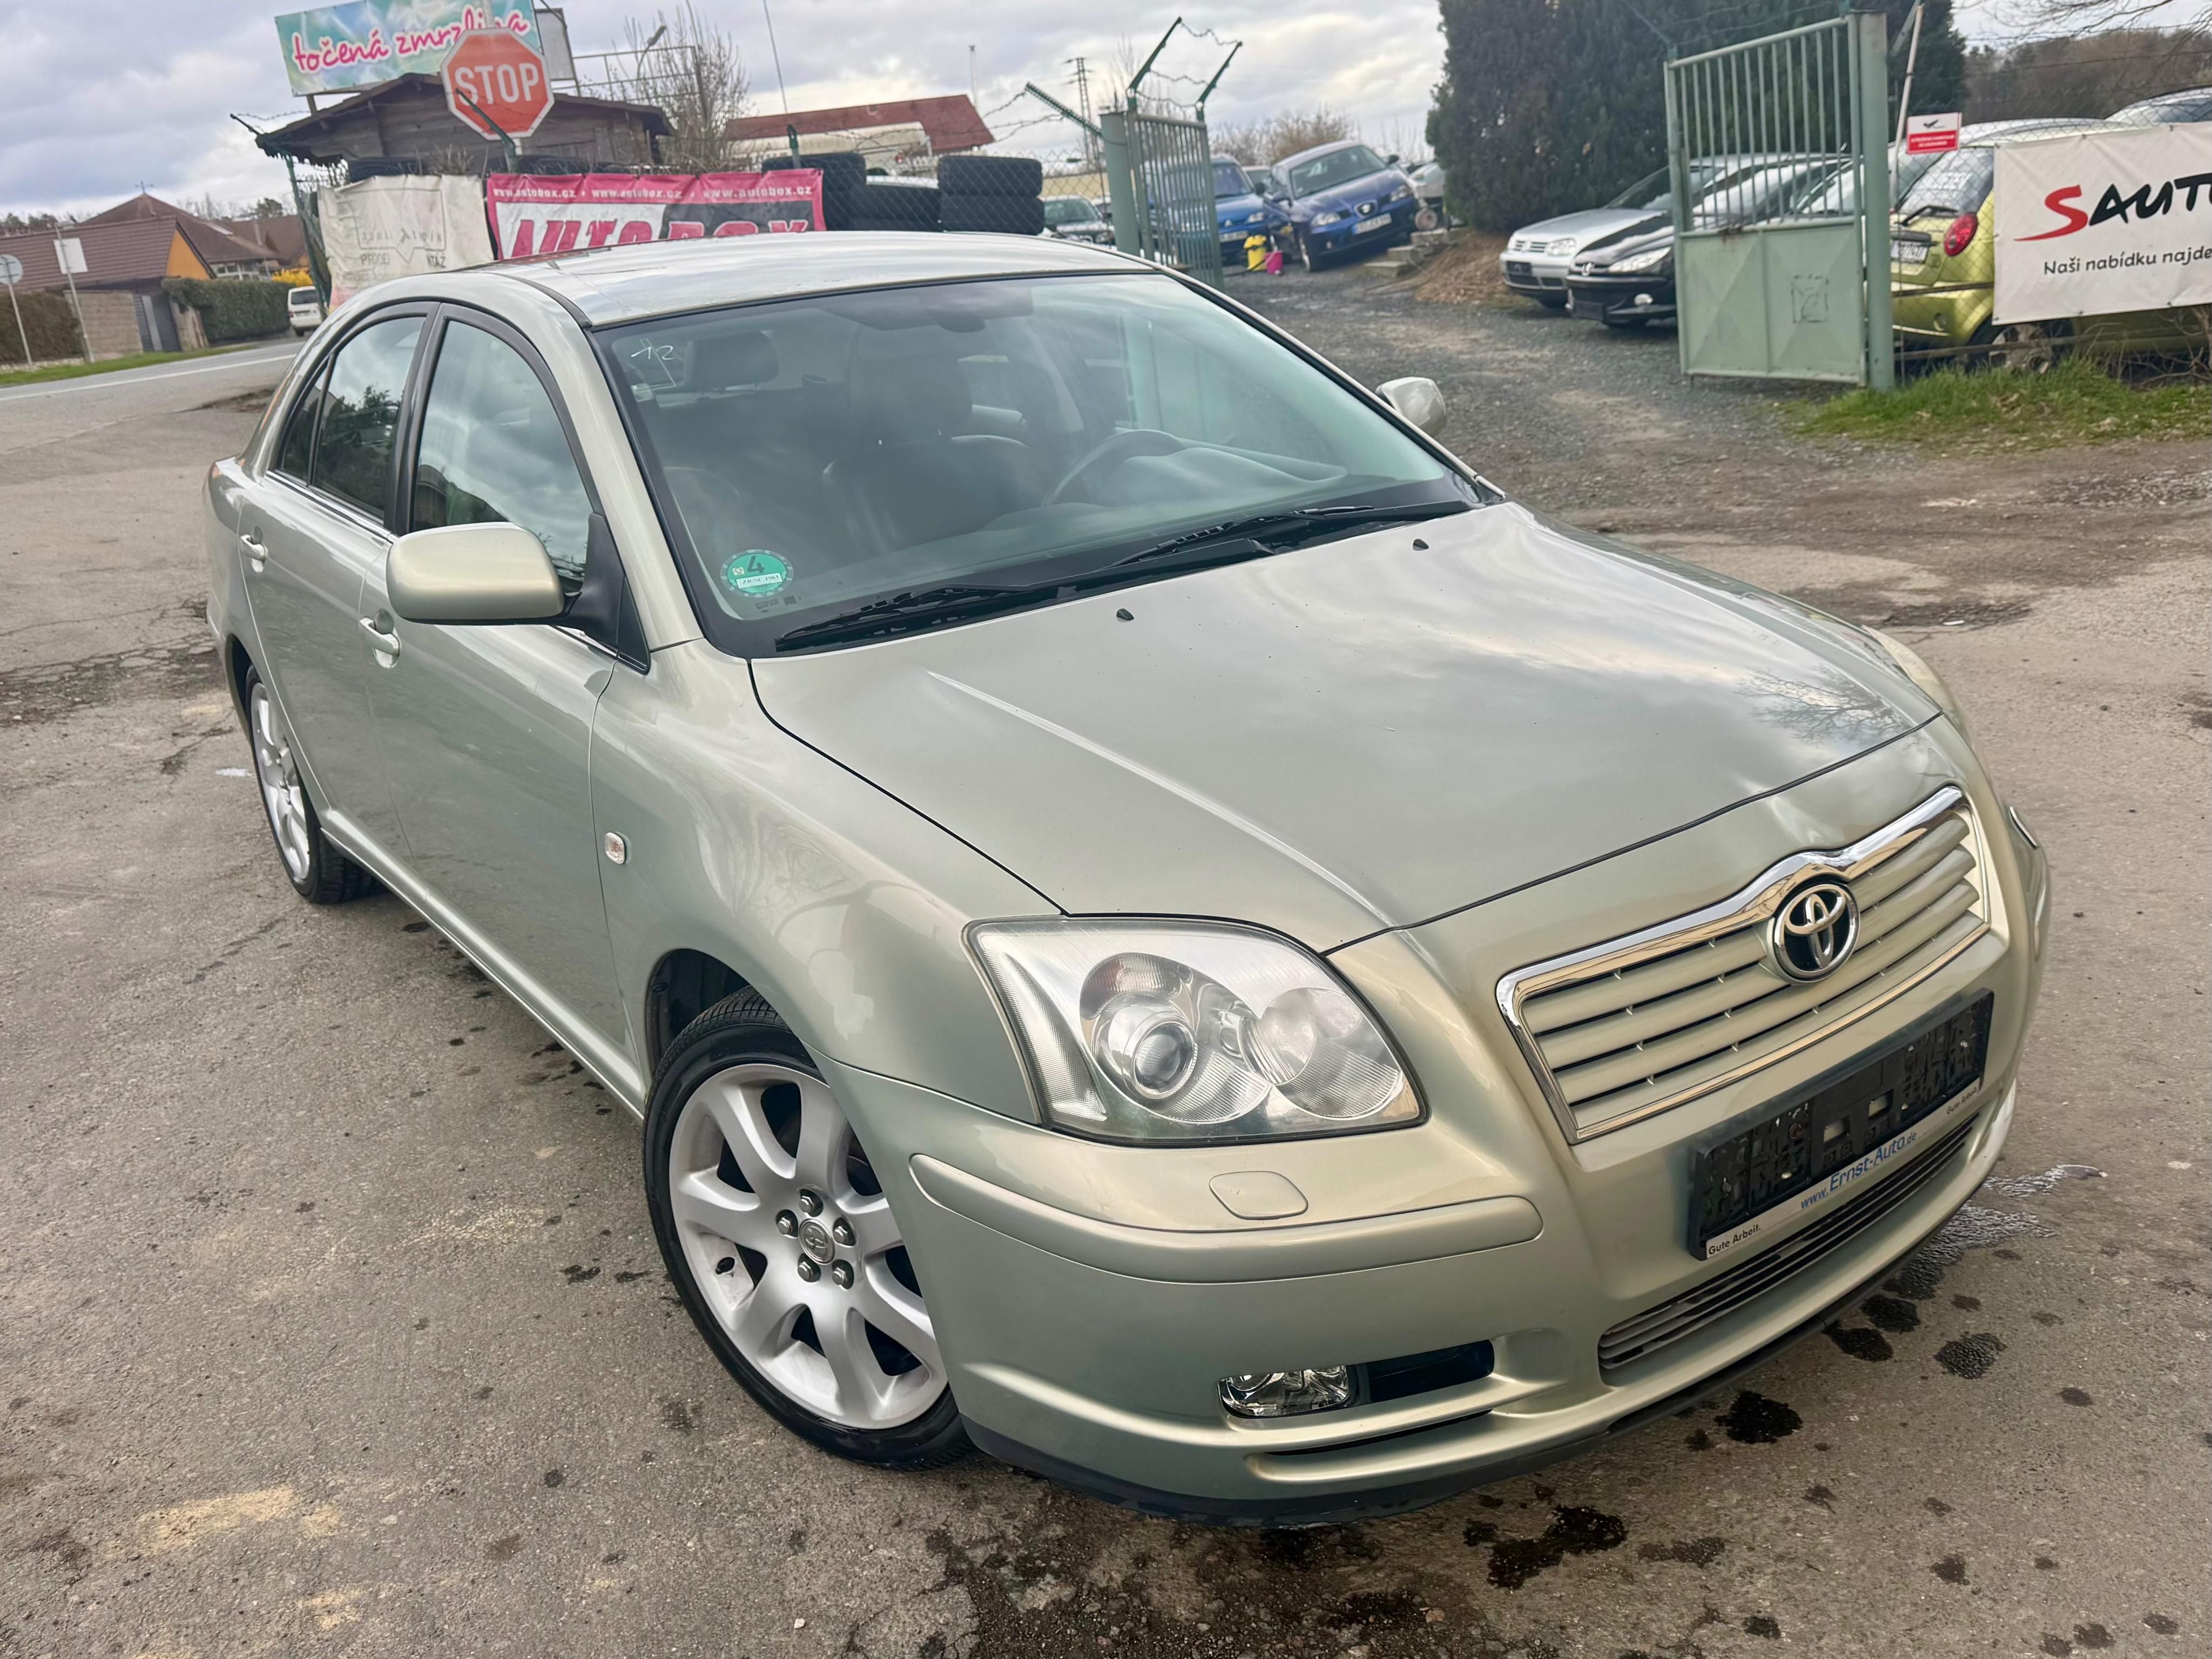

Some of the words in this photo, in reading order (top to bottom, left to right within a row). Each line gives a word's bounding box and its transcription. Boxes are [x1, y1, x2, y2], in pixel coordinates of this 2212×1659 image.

[294, 29, 389, 71] točená
[396, 8, 528, 54] zmrzlia
[454, 63, 539, 106] STOP
[2014, 172, 2212, 241] SAUT
[2044, 256, 2080, 275] Naši
[2086, 251, 2156, 271] nabídku
[747, 555, 765, 574] 4
[1708, 1236, 1730, 1256] Gute
[1732, 1224, 1762, 1244] Arbeit.
